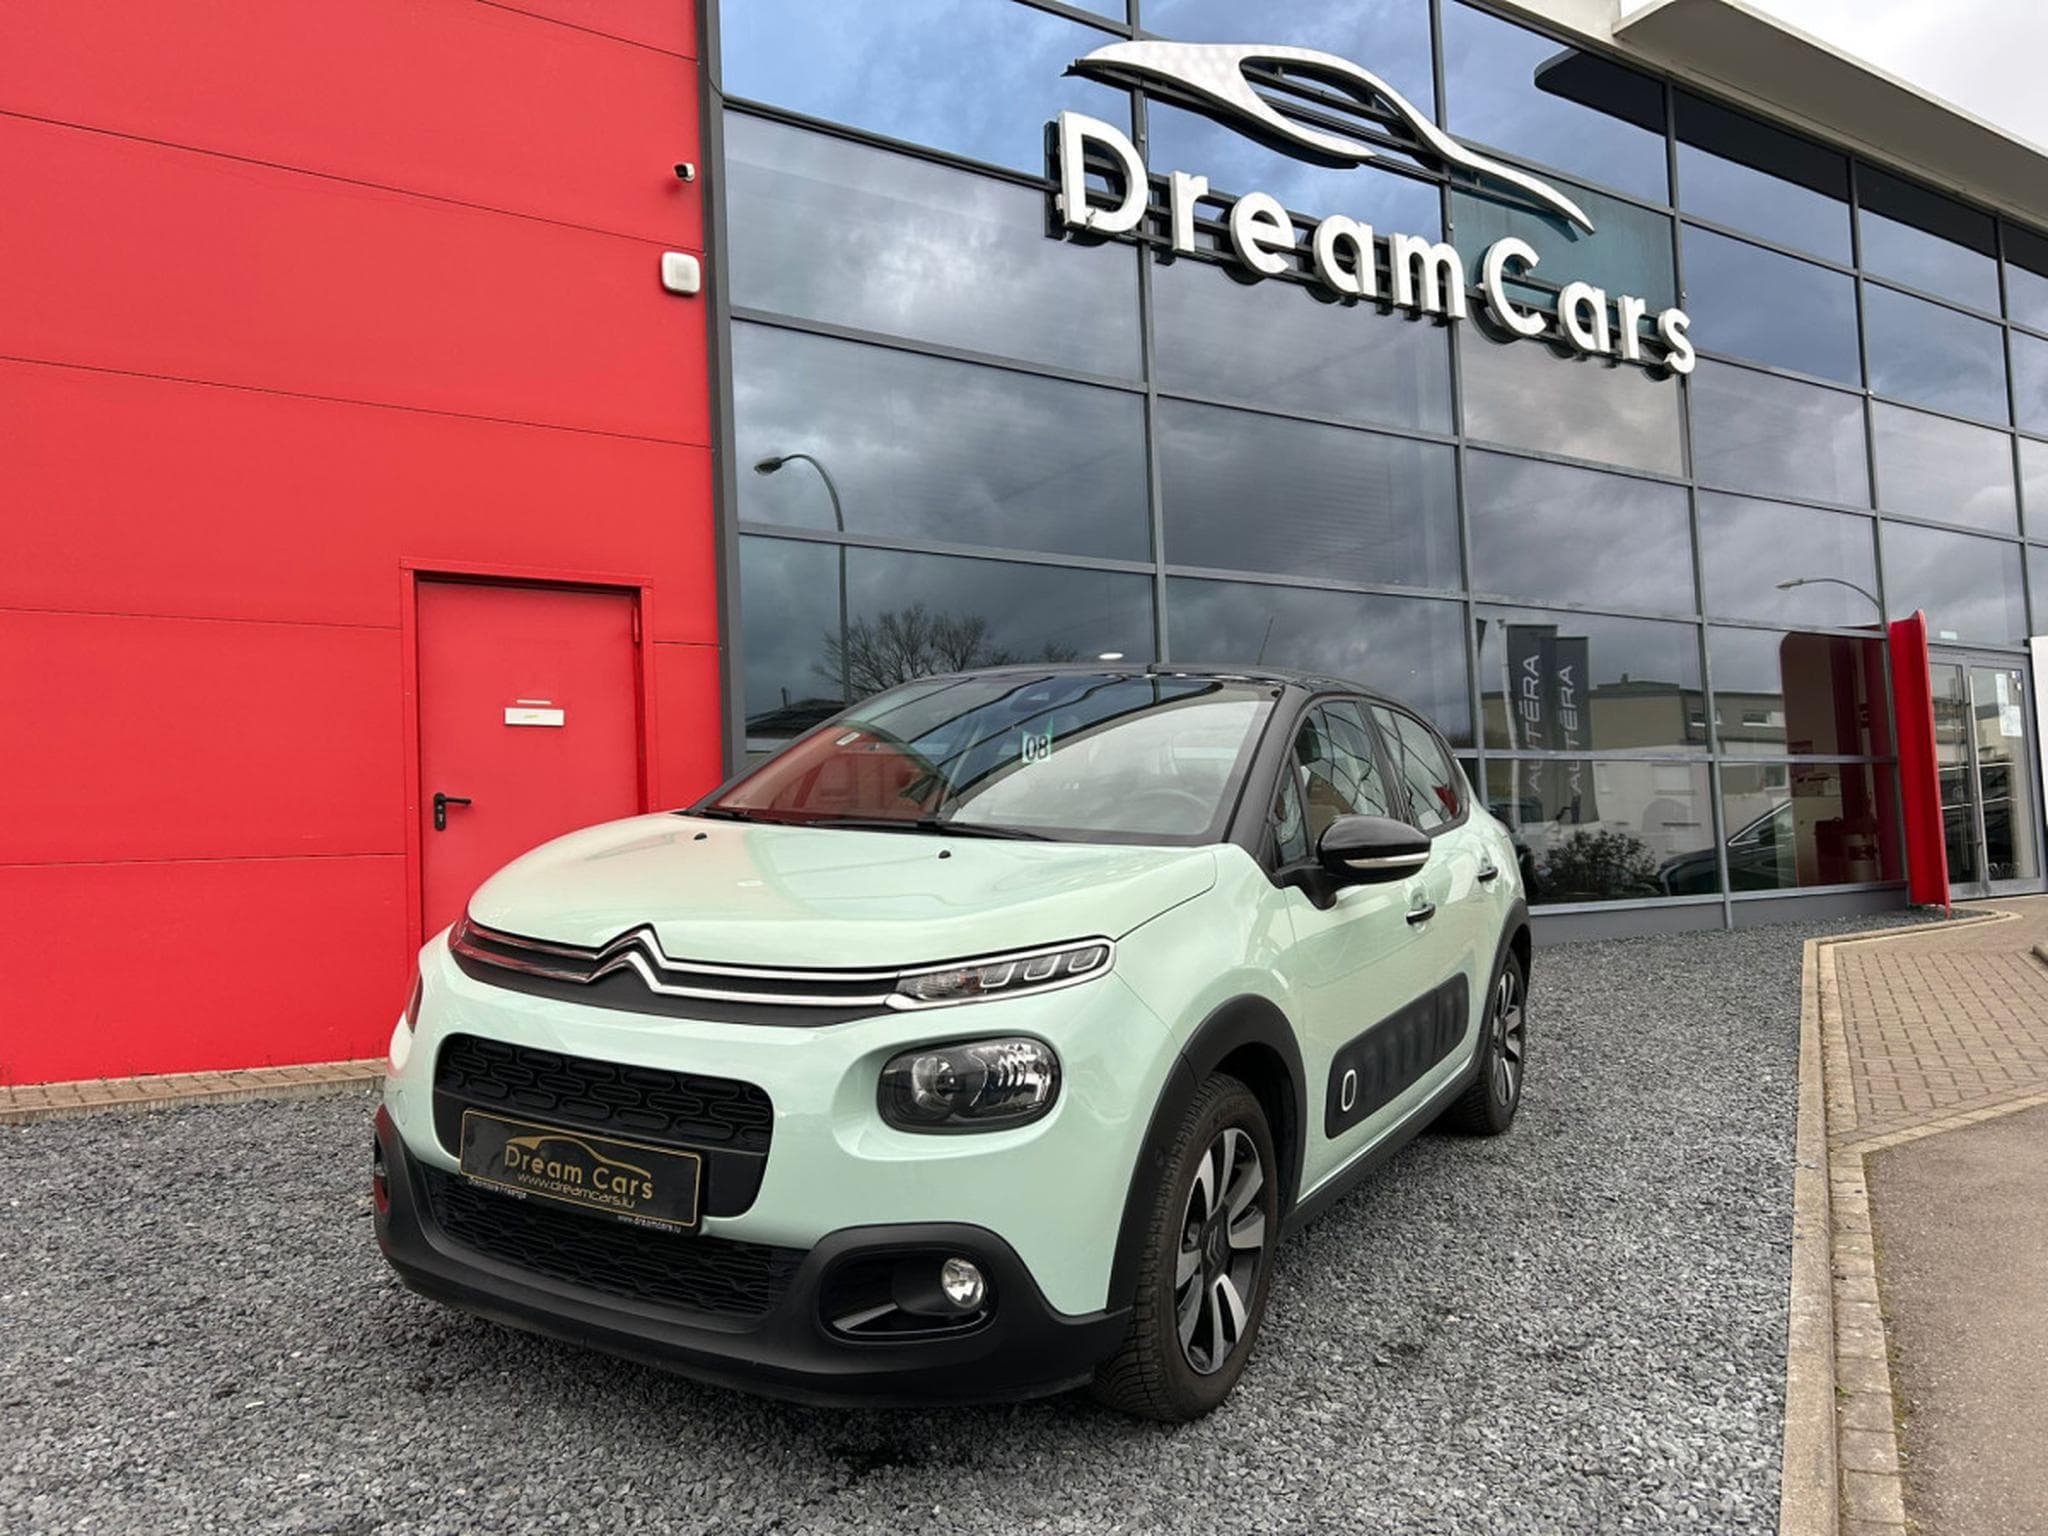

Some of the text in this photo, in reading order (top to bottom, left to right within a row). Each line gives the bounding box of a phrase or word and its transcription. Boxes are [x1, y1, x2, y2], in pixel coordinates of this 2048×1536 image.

[1026, 735, 1049, 760] 08
[504, 1145, 654, 1200] Dream Cars
[517, 1173, 636, 1209] www.dreamcars.lu
